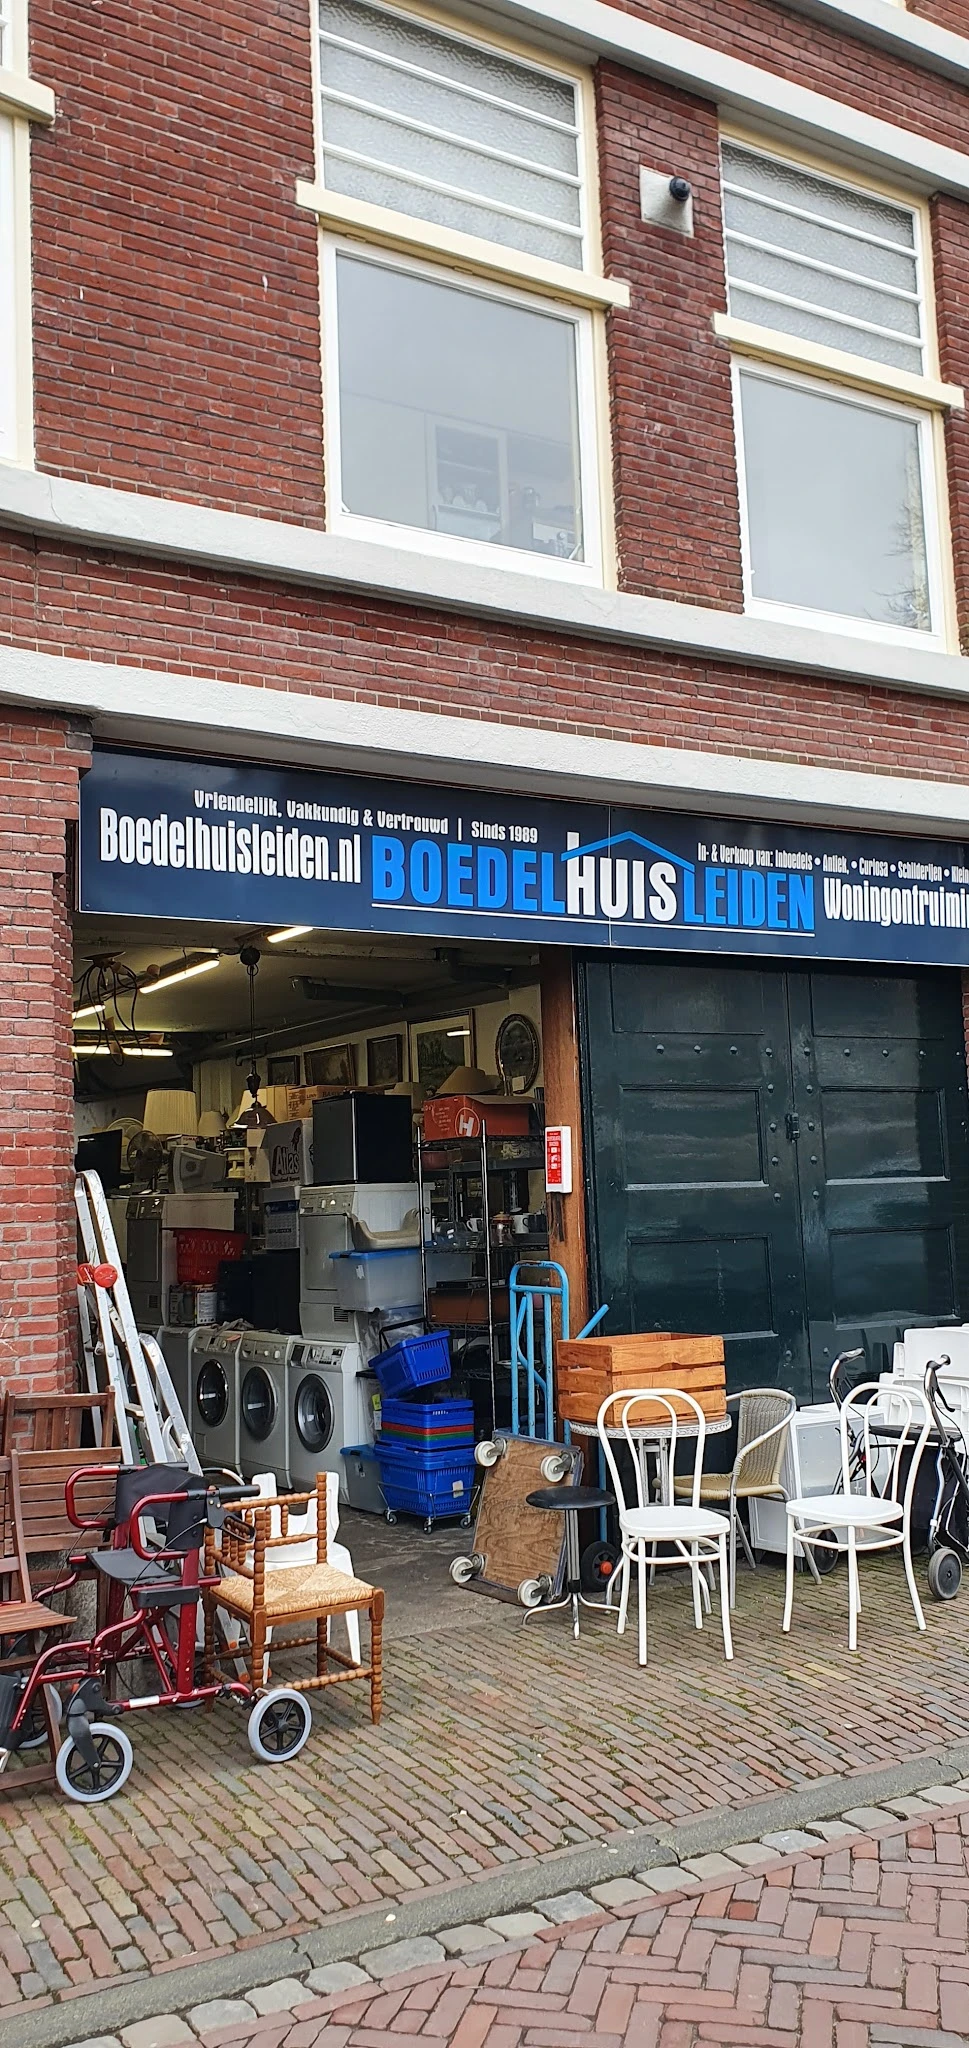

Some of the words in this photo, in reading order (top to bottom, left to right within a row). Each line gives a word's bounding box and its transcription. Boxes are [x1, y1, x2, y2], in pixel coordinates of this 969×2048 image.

[194, 789, 283, 818] Vriendelijk,
[286, 800, 359, 827] Vakkundig
[362, 809, 374, 827] &
[376, 810, 449, 835] Vertrouwd
[471, 820, 506, 841] Sinds
[508, 825, 538, 844] 1989
[99, 807, 362, 884] Boedelhuisleiden.nl
[697, 842, 709, 862] In-
[711, 843, 718, 862] &
[719, 844, 754, 868] Verkoop
[755, 849, 774, 868] van:
[775, 849, 813, 871] Inboedels
[822, 854, 850, 876] Antiek,
[859, 857, 889, 878] Curiosa
[897, 860, 943, 883] Schilderijen
[951, 865, 969, 885] Klein
[272, 1145, 300, 1177] Atlas
